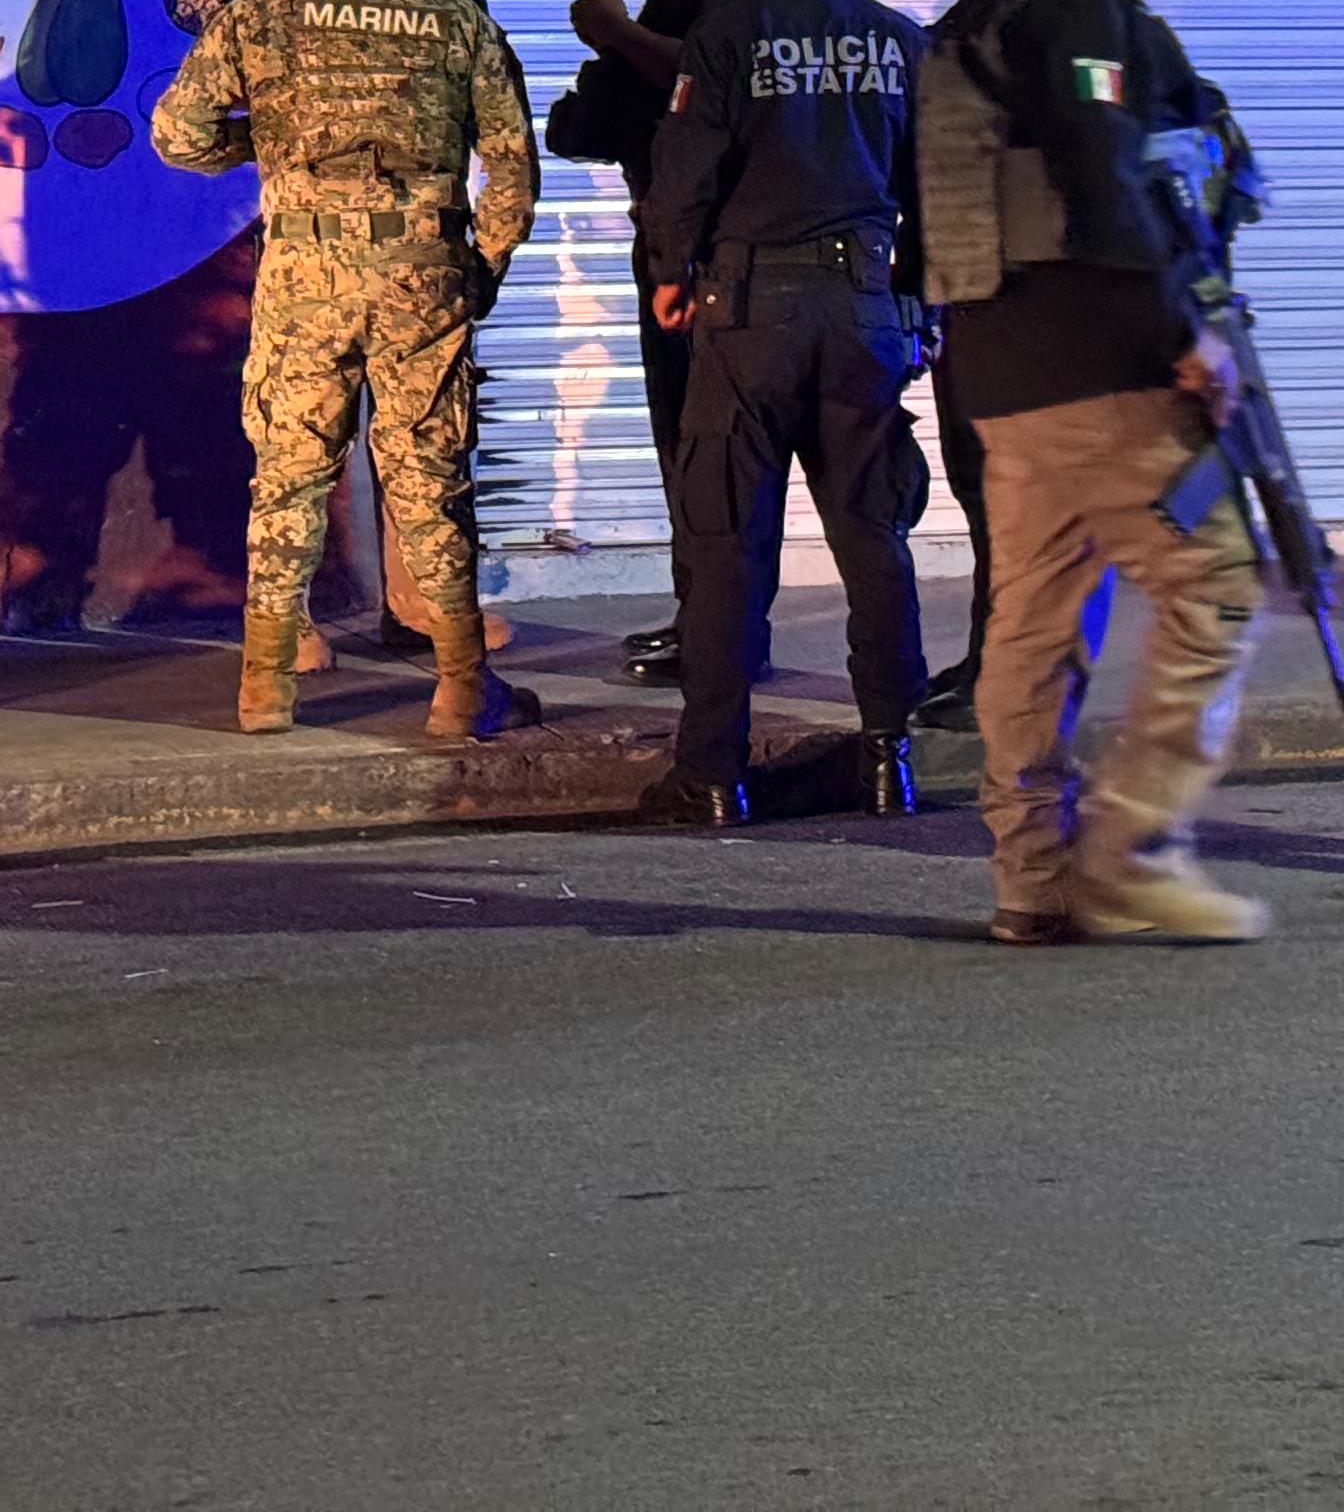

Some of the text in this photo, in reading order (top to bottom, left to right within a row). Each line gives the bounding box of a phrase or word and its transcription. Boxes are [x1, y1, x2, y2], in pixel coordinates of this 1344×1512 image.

[304, 1, 441, 38] MARINA
[751, 30, 905, 69] POLICÍA
[750, 64, 905, 99] ESTATAL
